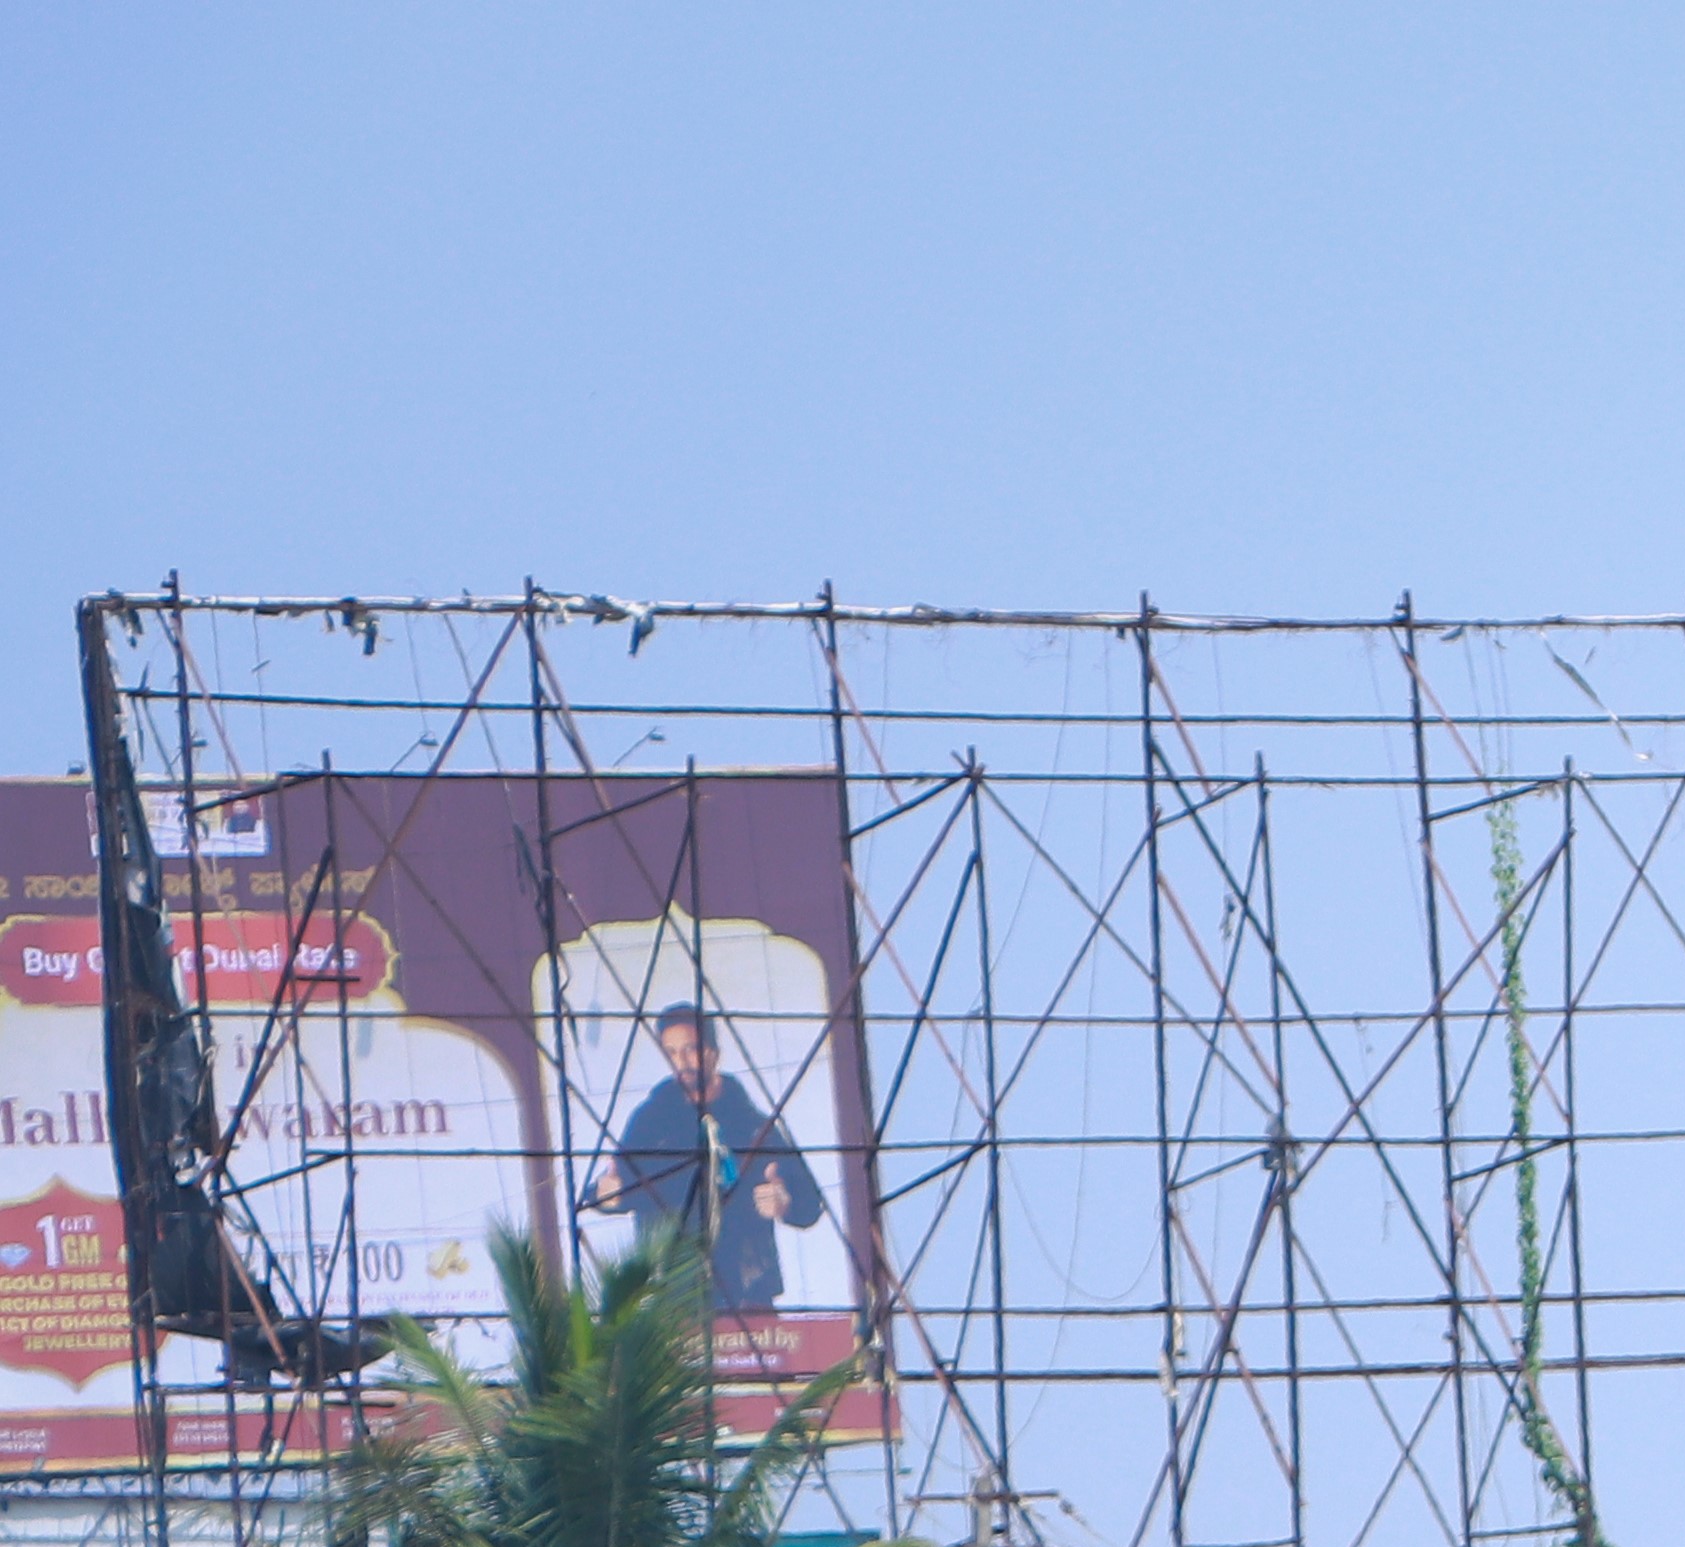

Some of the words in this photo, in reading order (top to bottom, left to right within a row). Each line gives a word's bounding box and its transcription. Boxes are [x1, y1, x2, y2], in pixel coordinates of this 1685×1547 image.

[22, 947, 78, 981] Buy
[36, 1215, 60, 1268] 1
[61, 1233, 100, 1265] GM
